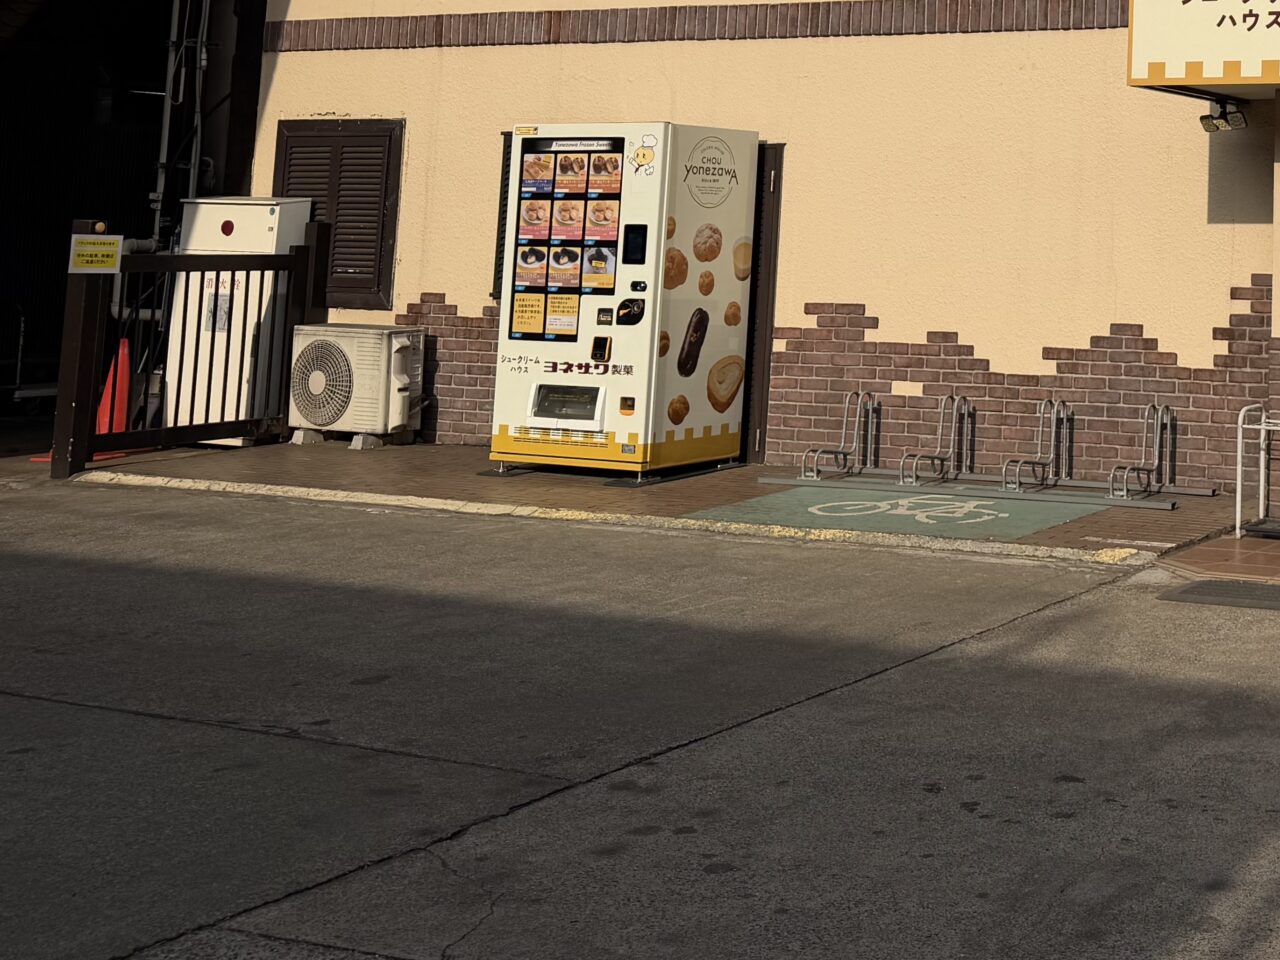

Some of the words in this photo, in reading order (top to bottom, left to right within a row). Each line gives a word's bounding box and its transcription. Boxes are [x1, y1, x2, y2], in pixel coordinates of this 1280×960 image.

[701, 156, 722, 165] CHOU
[500, 354, 541, 365] シュークリーム
[509, 366, 529, 374] ハウス
